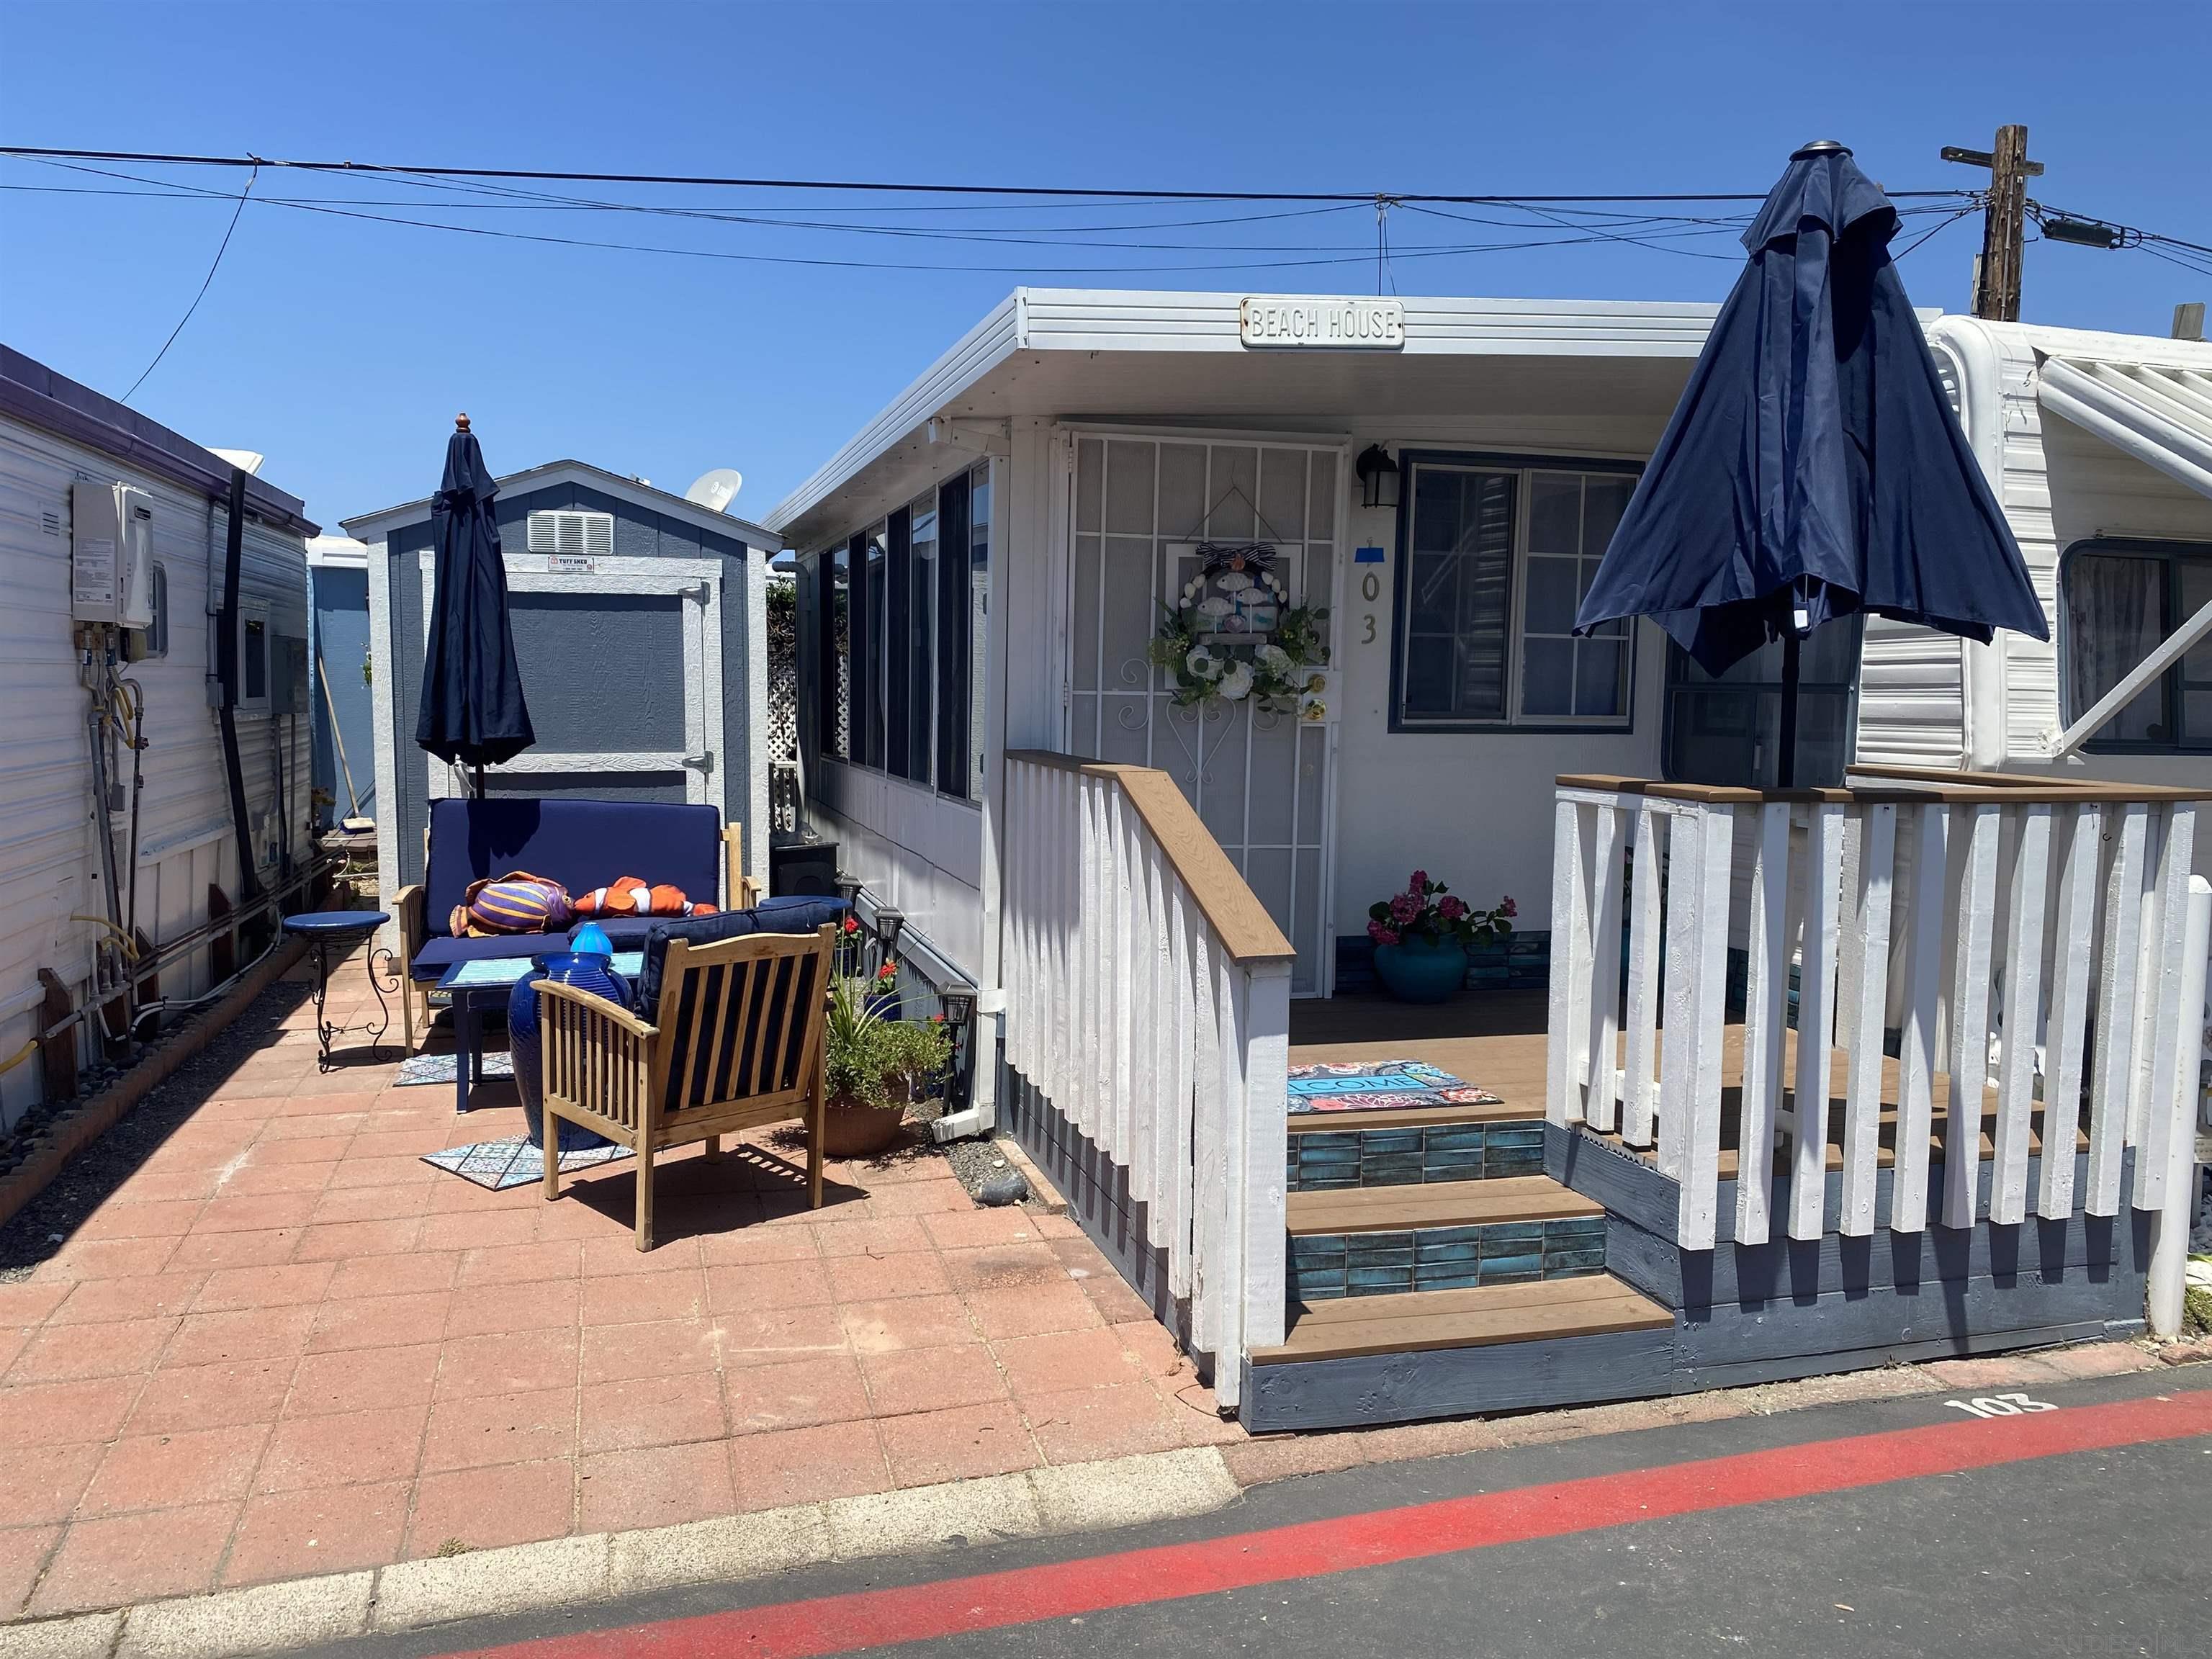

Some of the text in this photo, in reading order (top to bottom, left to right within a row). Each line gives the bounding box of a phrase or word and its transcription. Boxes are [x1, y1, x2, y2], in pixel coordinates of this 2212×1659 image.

[1251, 307, 1397, 339] BEACH HOUSE
[1287, 1077, 1420, 1093] LCOME
[1943, 1393, 2059, 1419] 103
